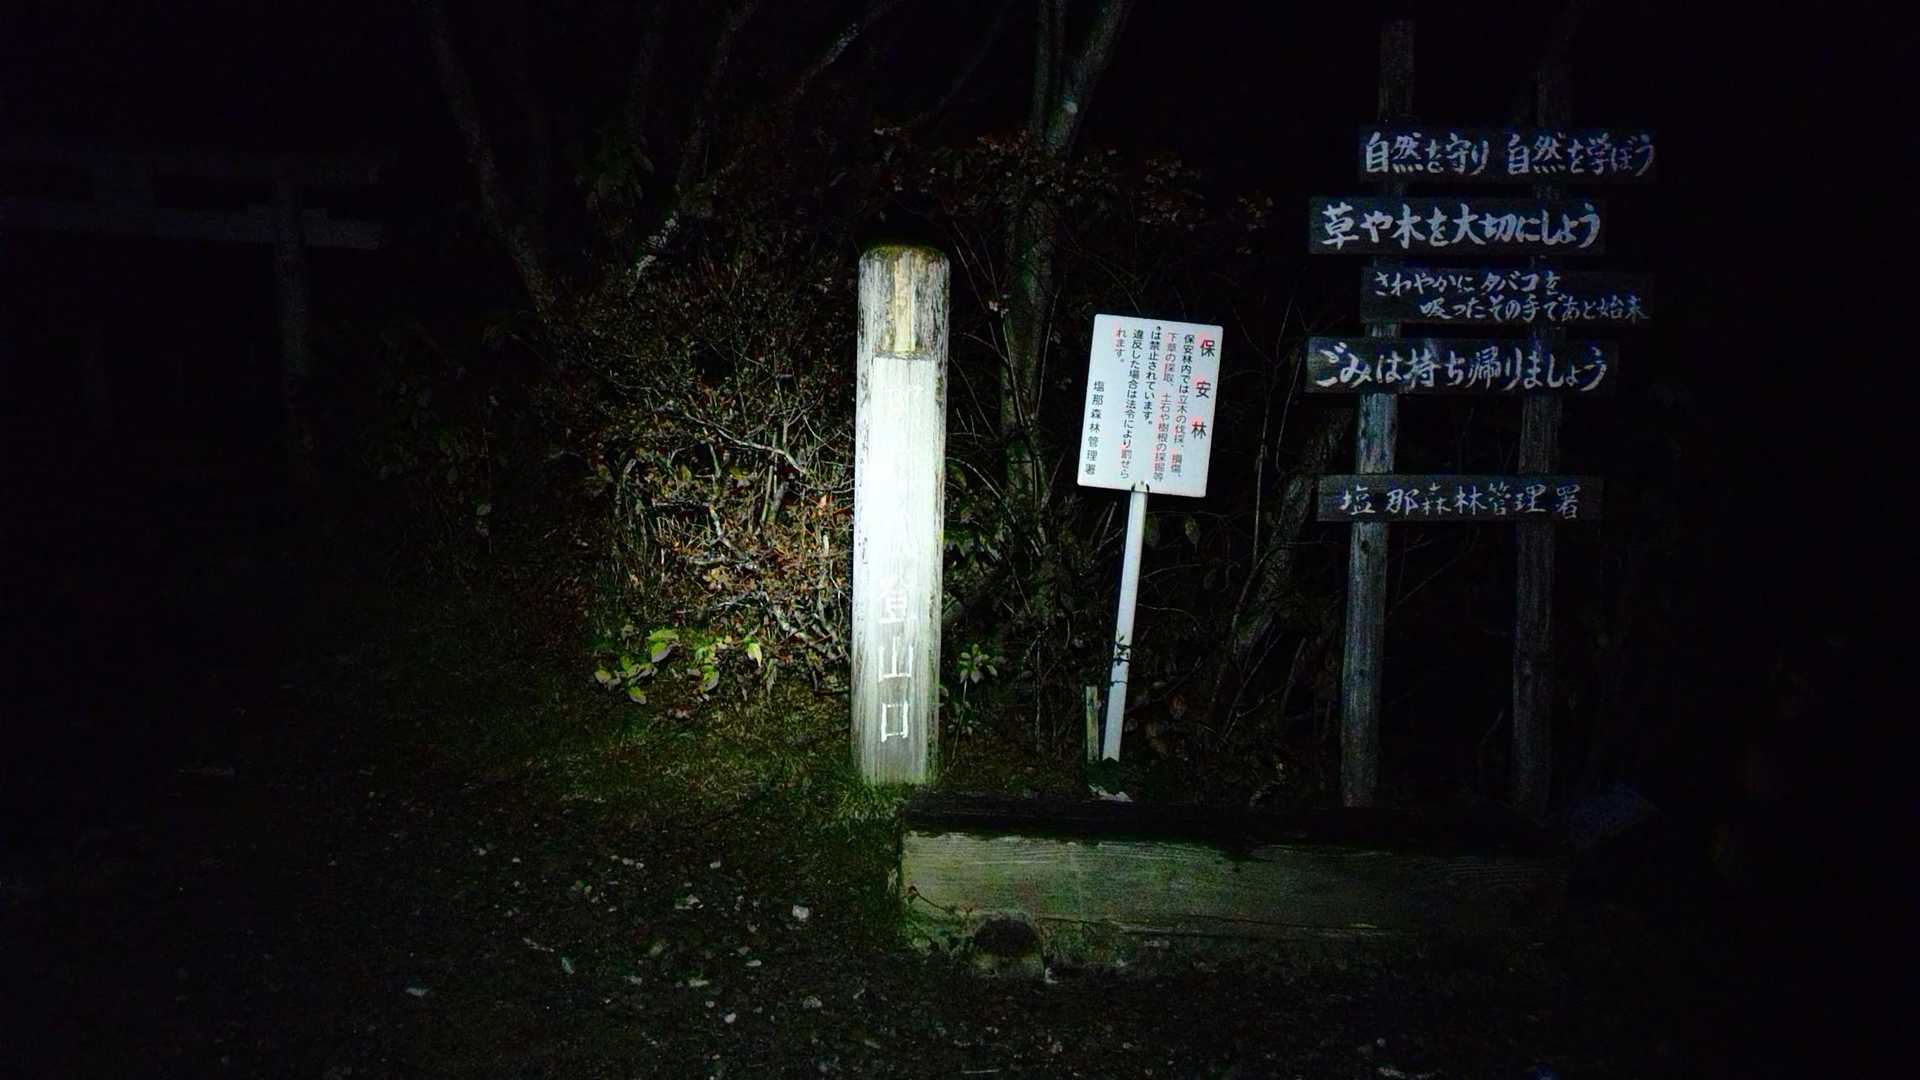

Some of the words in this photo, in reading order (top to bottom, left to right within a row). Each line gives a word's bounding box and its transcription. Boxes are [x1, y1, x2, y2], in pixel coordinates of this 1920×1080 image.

[1364, 131, 1490, 175] 自然を守り
[1505, 132, 1656, 177] 自然を学ぼう
[1115, 328, 1127, 363] れます。
[1315, 341, 1608, 392] ごみは持ち帰りましょう
[1143, 331, 1161, 425] は禁止されています。
[1192, 338, 1216, 440] 保安林
[1085, 381, 1104, 475] 塩那森林管理署
[1338, 482, 1582, 520] 塩那森林管理署
